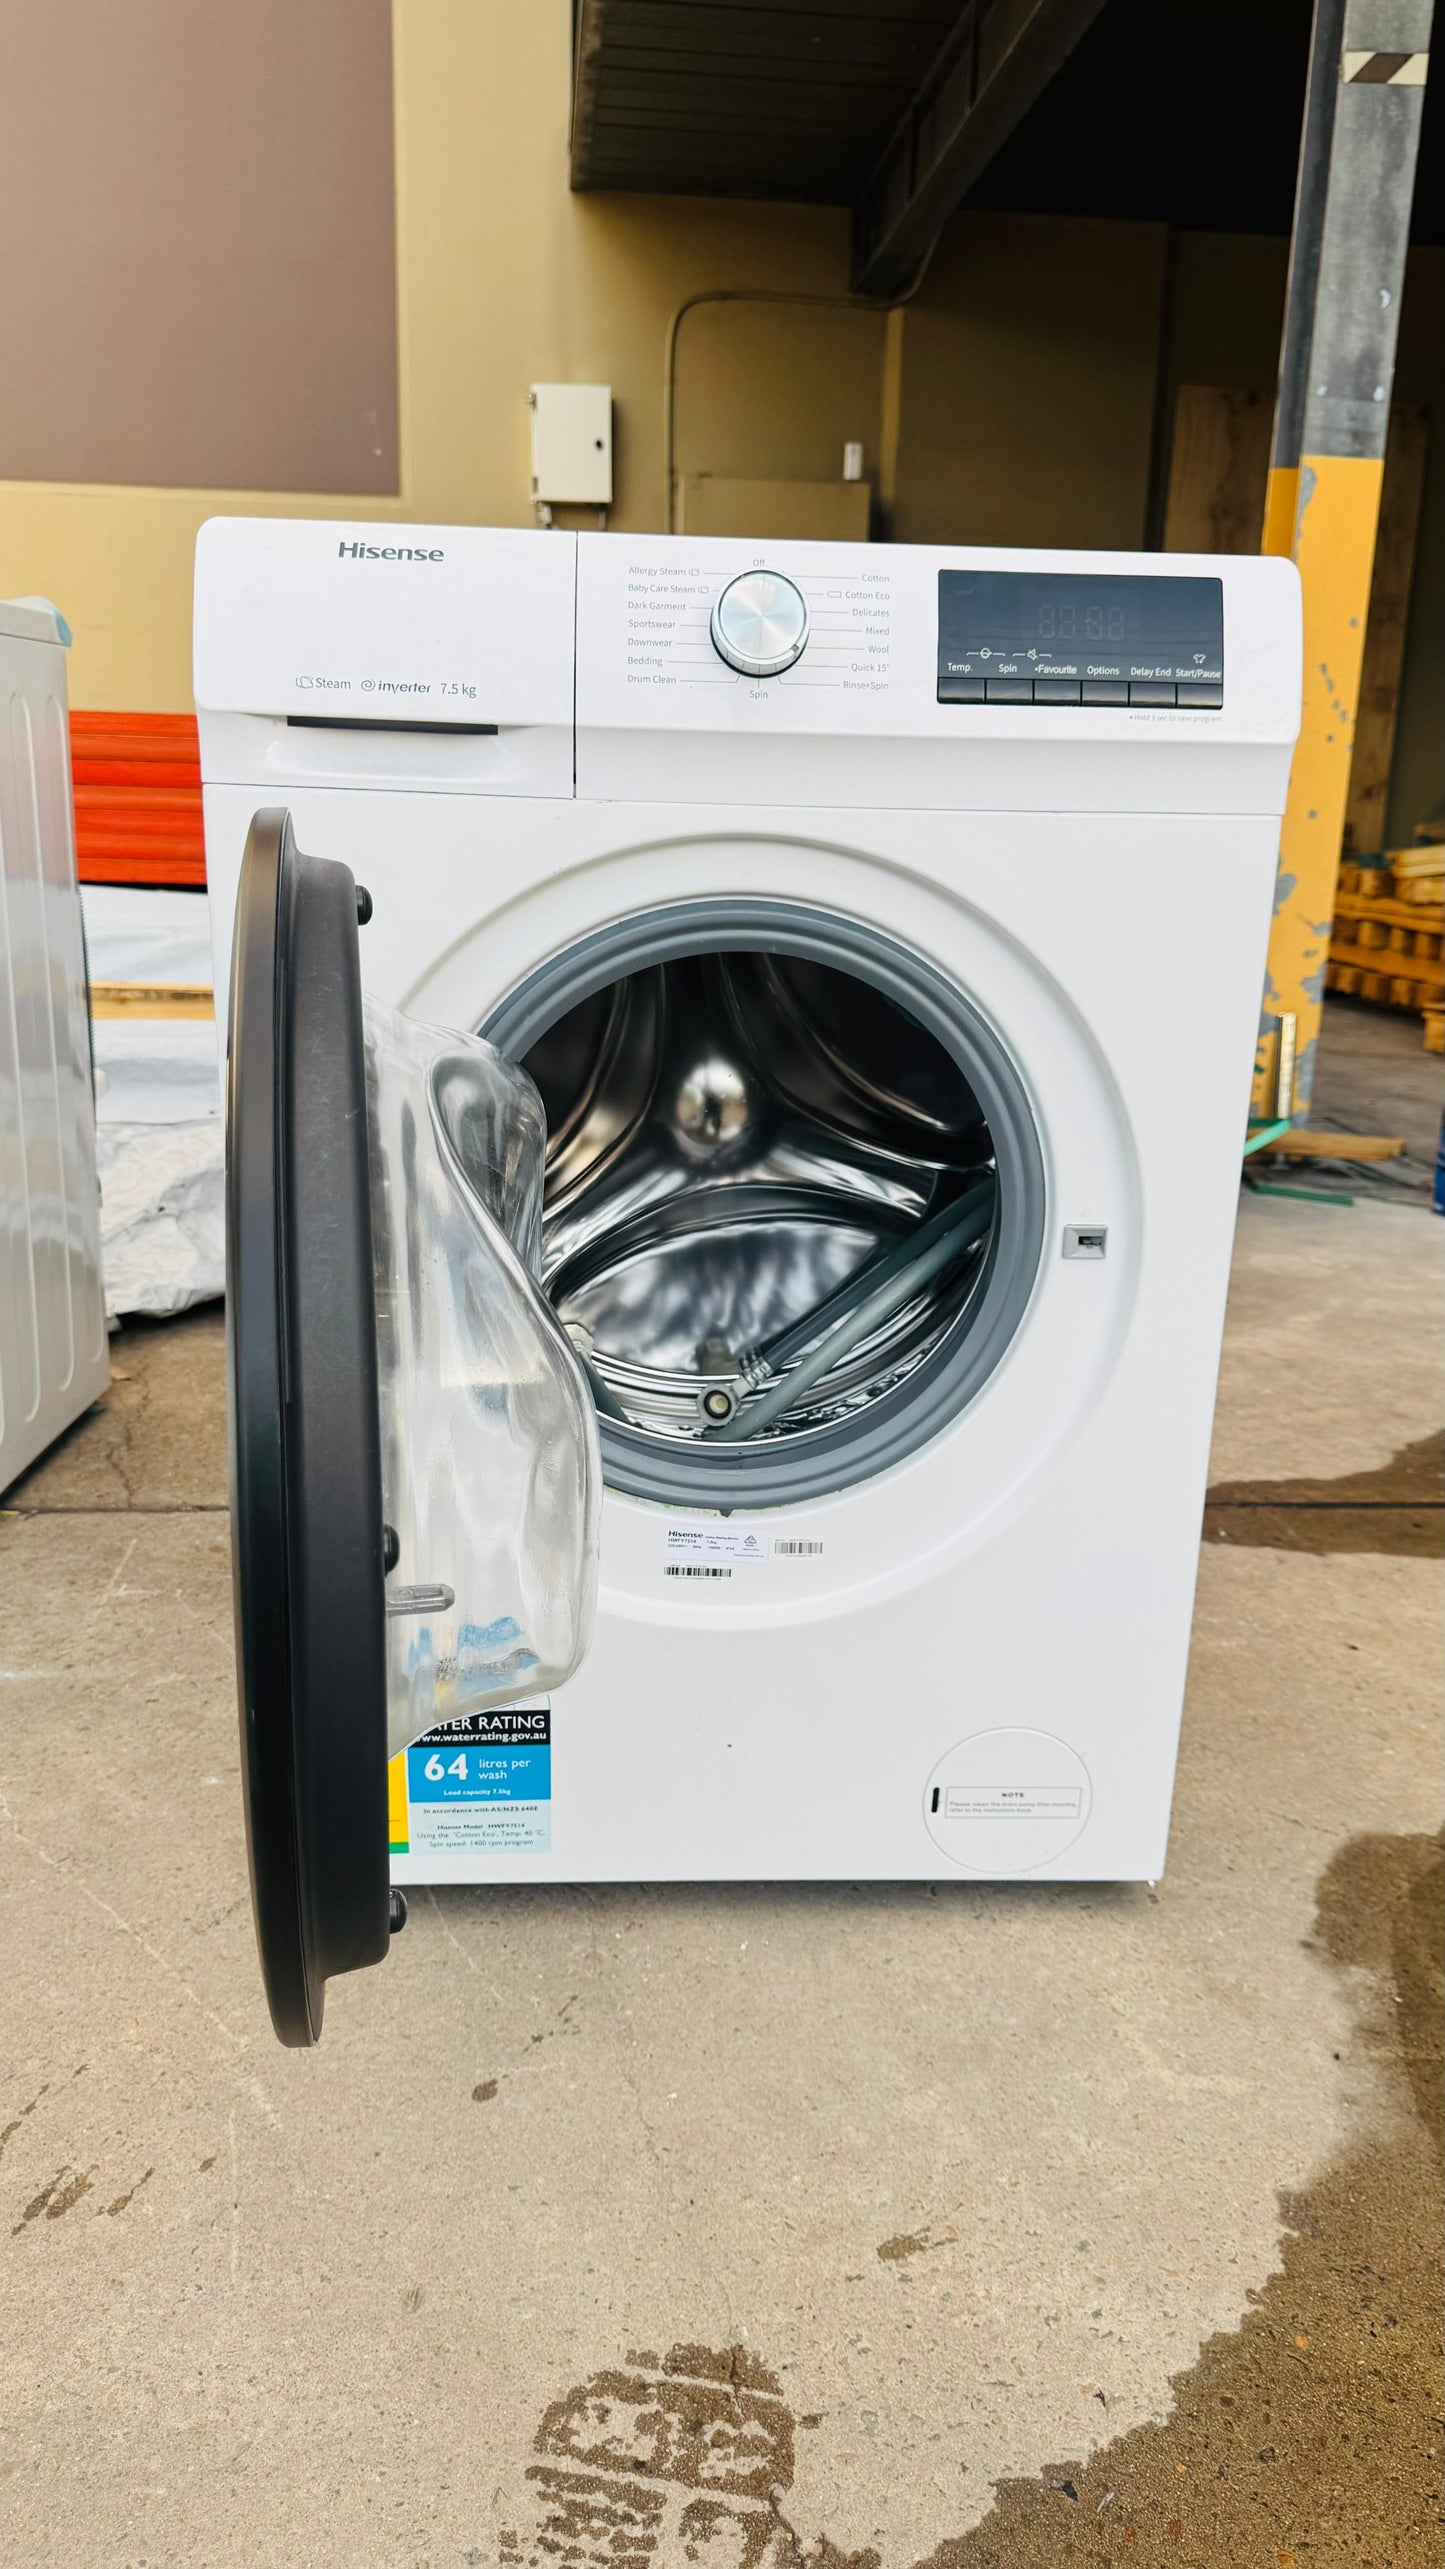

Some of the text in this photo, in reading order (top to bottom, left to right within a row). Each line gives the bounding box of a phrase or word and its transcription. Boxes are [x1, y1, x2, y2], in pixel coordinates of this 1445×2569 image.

[338, 542, 444, 562] Hisense
[753, 559, 766, 567] Off
[629, 566, 686, 576] Allergy Steam
[862, 574, 890, 582] Cotton
[628, 584, 696, 594] Baby Care Steam
[845, 591, 890, 600] Cotton Eco
[628, 601, 686, 611] Dark Garment
[852, 608, 890, 618] Delicates
[628, 619, 676, 629] Sportswear
[866, 626, 890, 636] Mixed
[628, 638, 672, 647] Downwear
[868, 645, 890, 654] Wool
[628, 656, 663, 668] Bedding
[851, 663, 875, 672] Quick
[947, 663, 973, 674] Temp.
[998, 664, 1018, 674] Spin
[1087, 666, 1120, 676] Options
[1130, 667, 1172, 678] Delay End
[1175, 668, 1221, 679] Start/Pause
[315, 676, 351, 690] Steam
[628, 674, 676, 684] Drum Clean
[378, 680, 431, 694] inverter
[440, 682, 477, 699] 7.5 kg
[750, 690, 768, 700] Spin
[1152, 714, 1156, 722] 3
[668, 1530, 703, 1539] Hisense
[478, 1715, 545, 1729] RATING
[424, 1753, 468, 1781] 64
[479, 1758, 531, 1770] litres per
[478, 1770, 508, 1780] wash
[504, 1840, 534, 1848] program
